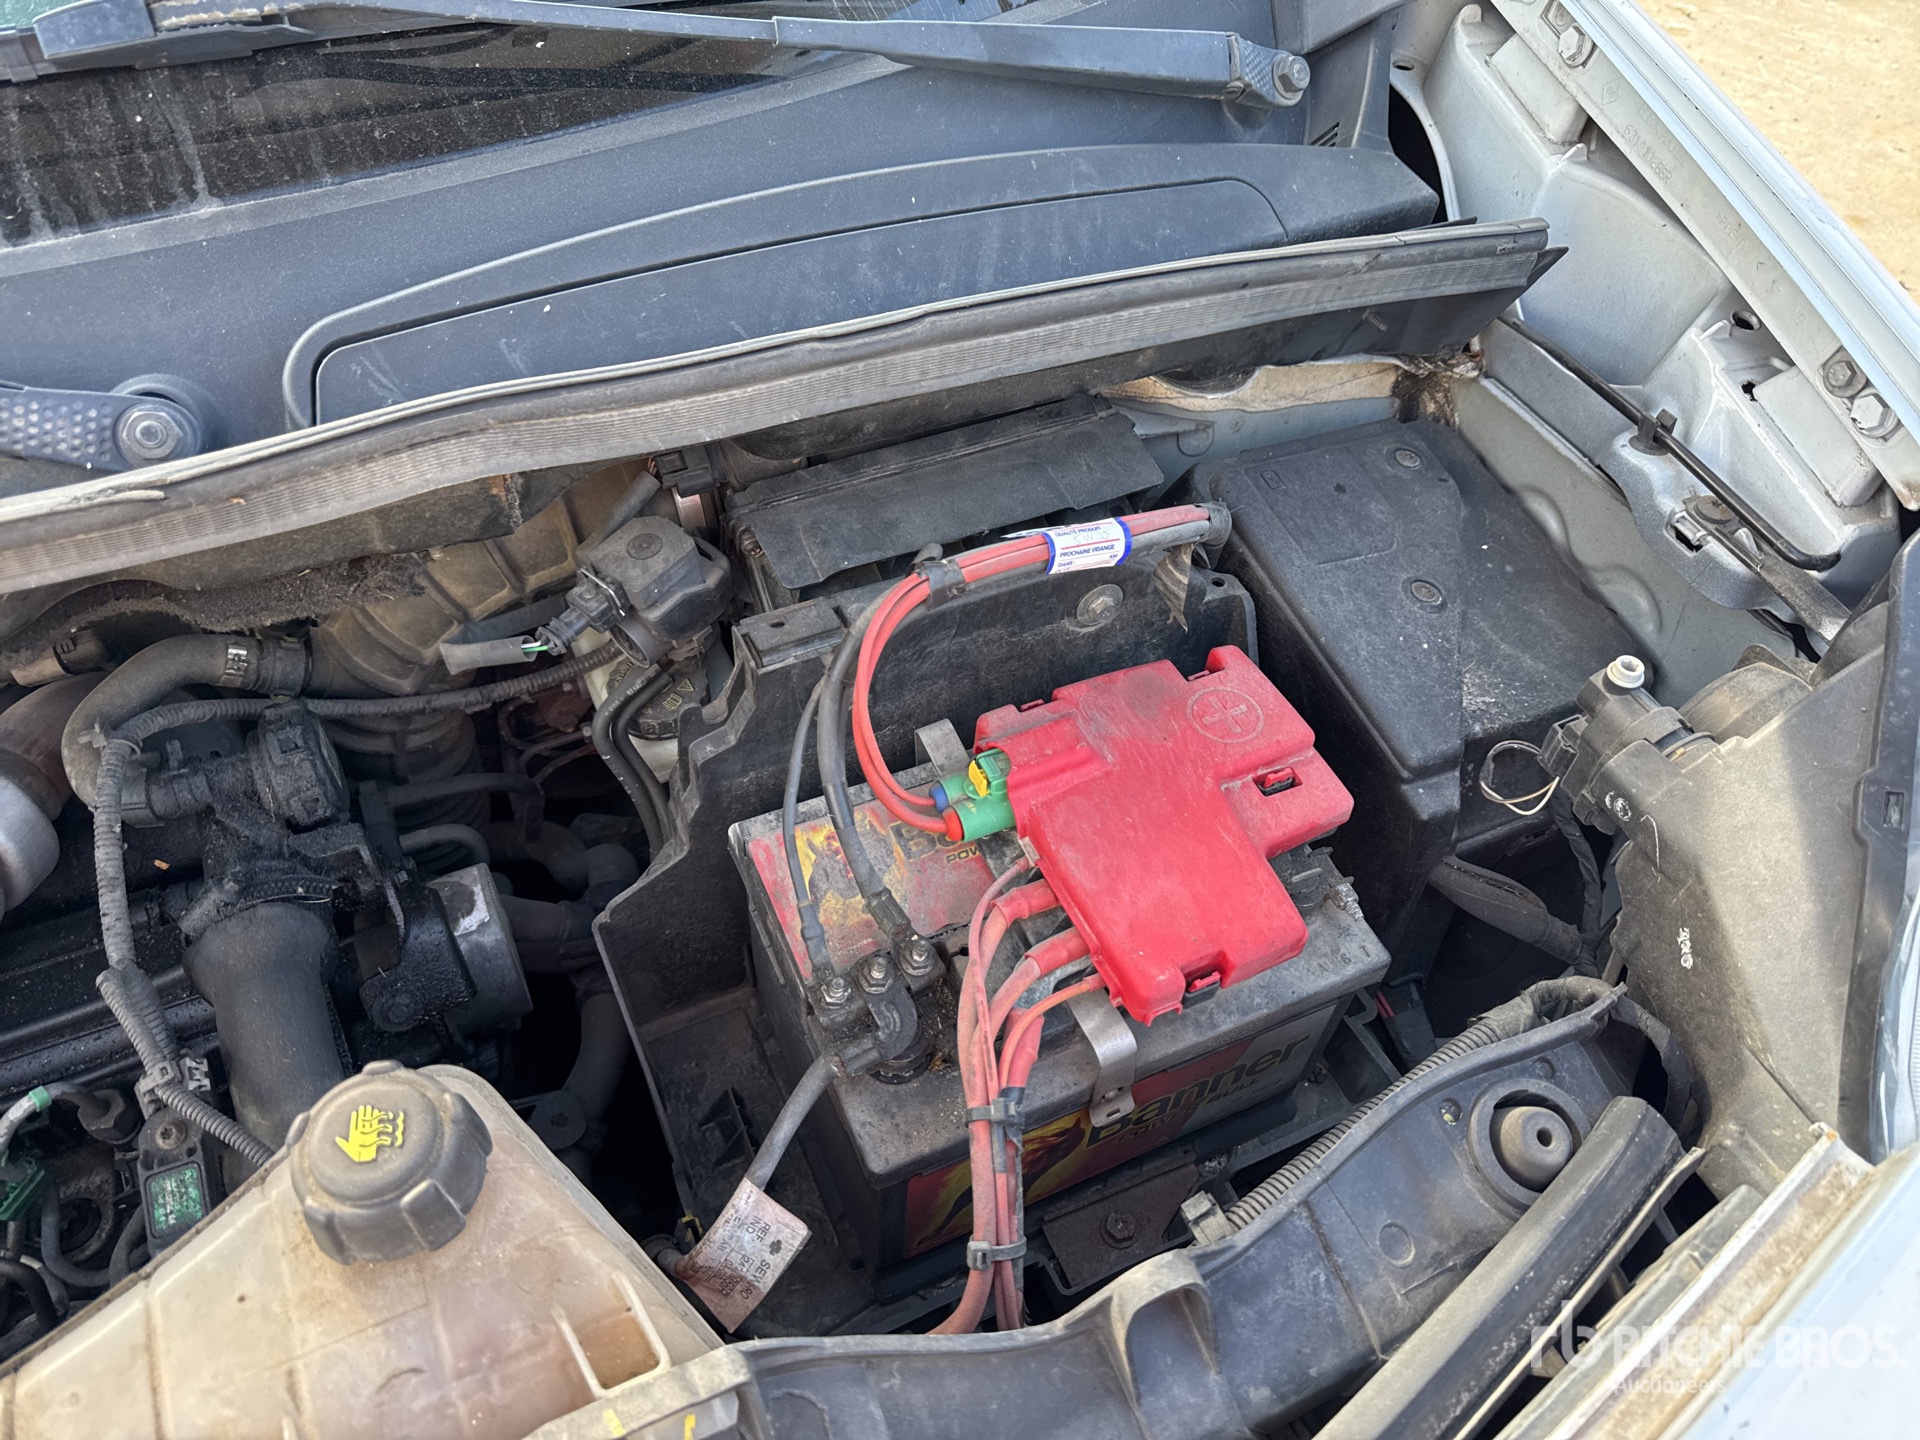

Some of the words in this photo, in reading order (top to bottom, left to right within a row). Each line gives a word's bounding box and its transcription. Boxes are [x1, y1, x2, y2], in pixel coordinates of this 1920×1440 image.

[1059, 547, 1091, 558] PROCHAINE
[1092, 544, 1115, 553] VIDANGE
[1205, 1077, 1261, 1105] BULL
[745, 1215, 760, 1235] IND
